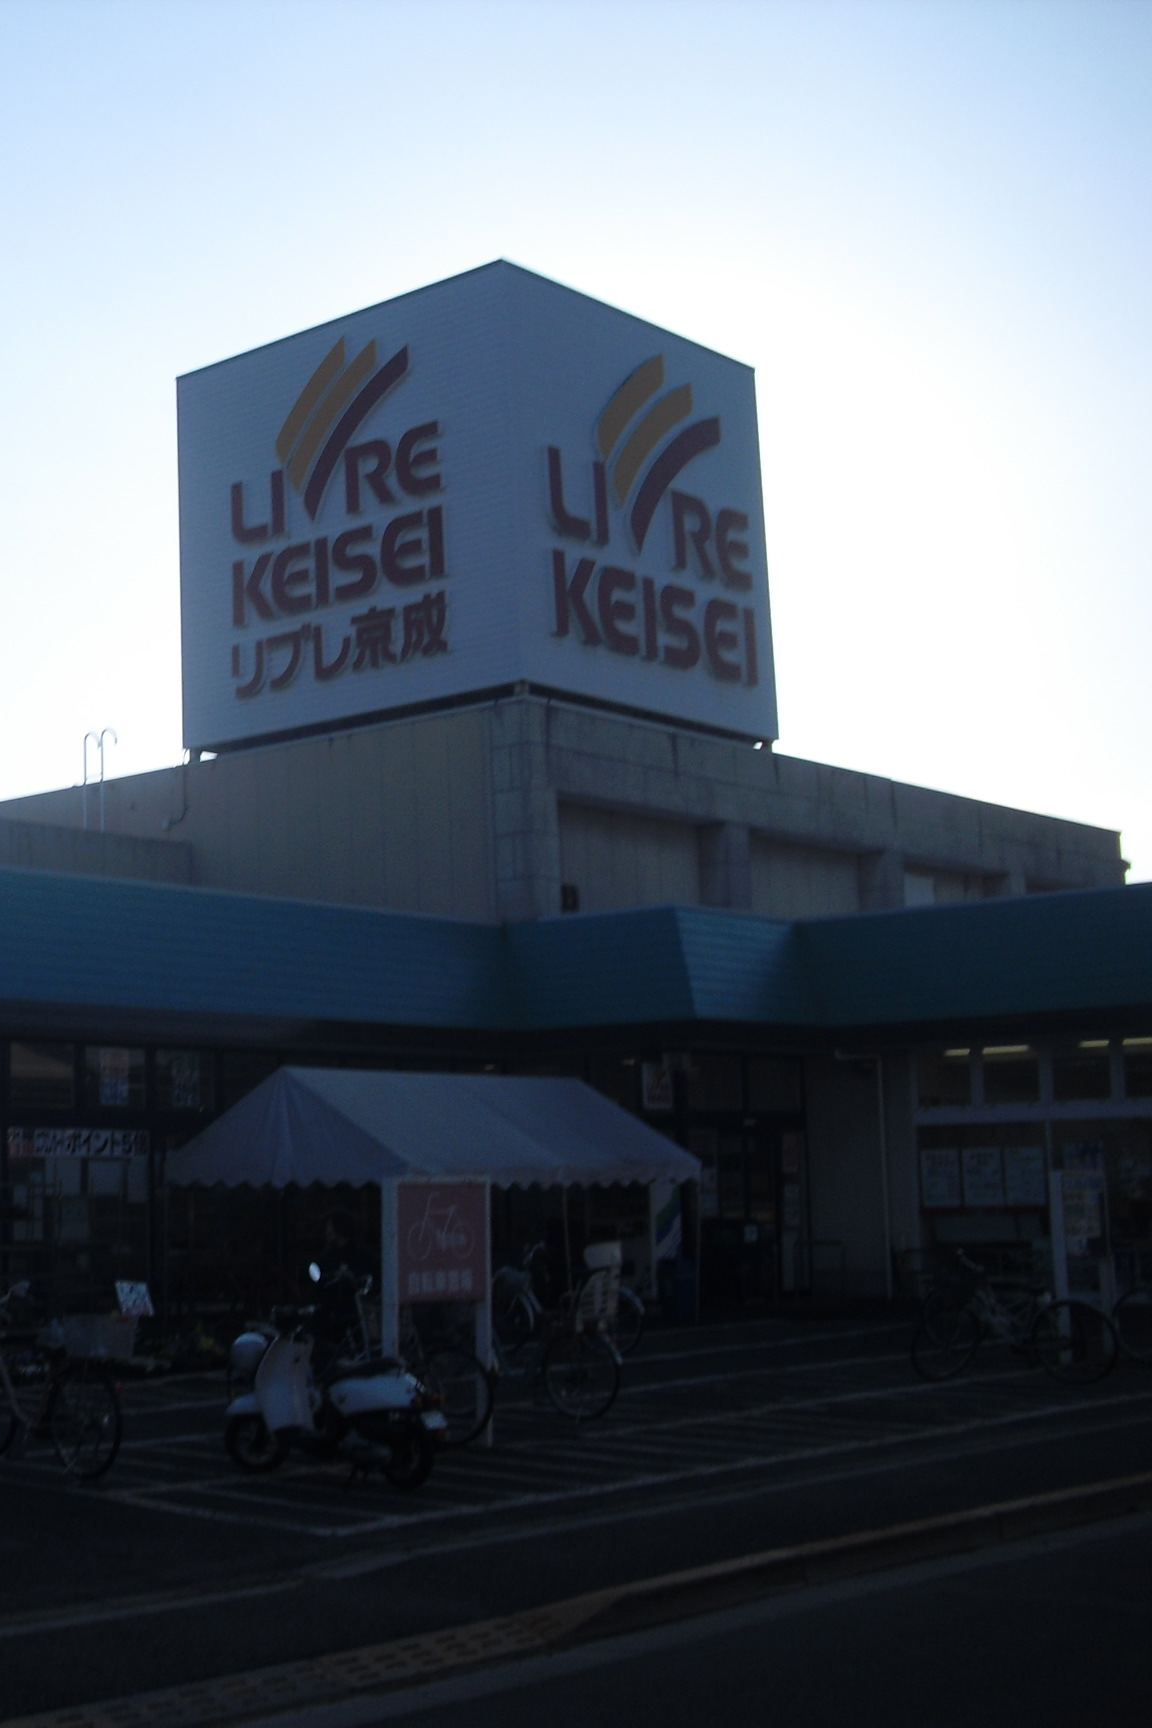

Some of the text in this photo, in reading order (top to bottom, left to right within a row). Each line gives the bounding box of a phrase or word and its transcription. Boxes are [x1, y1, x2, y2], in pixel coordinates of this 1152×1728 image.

[231, 504, 448, 630] KEISEI
[550, 547, 760, 689] KEISEI
[230, 589, 449, 700] リブレ京成
